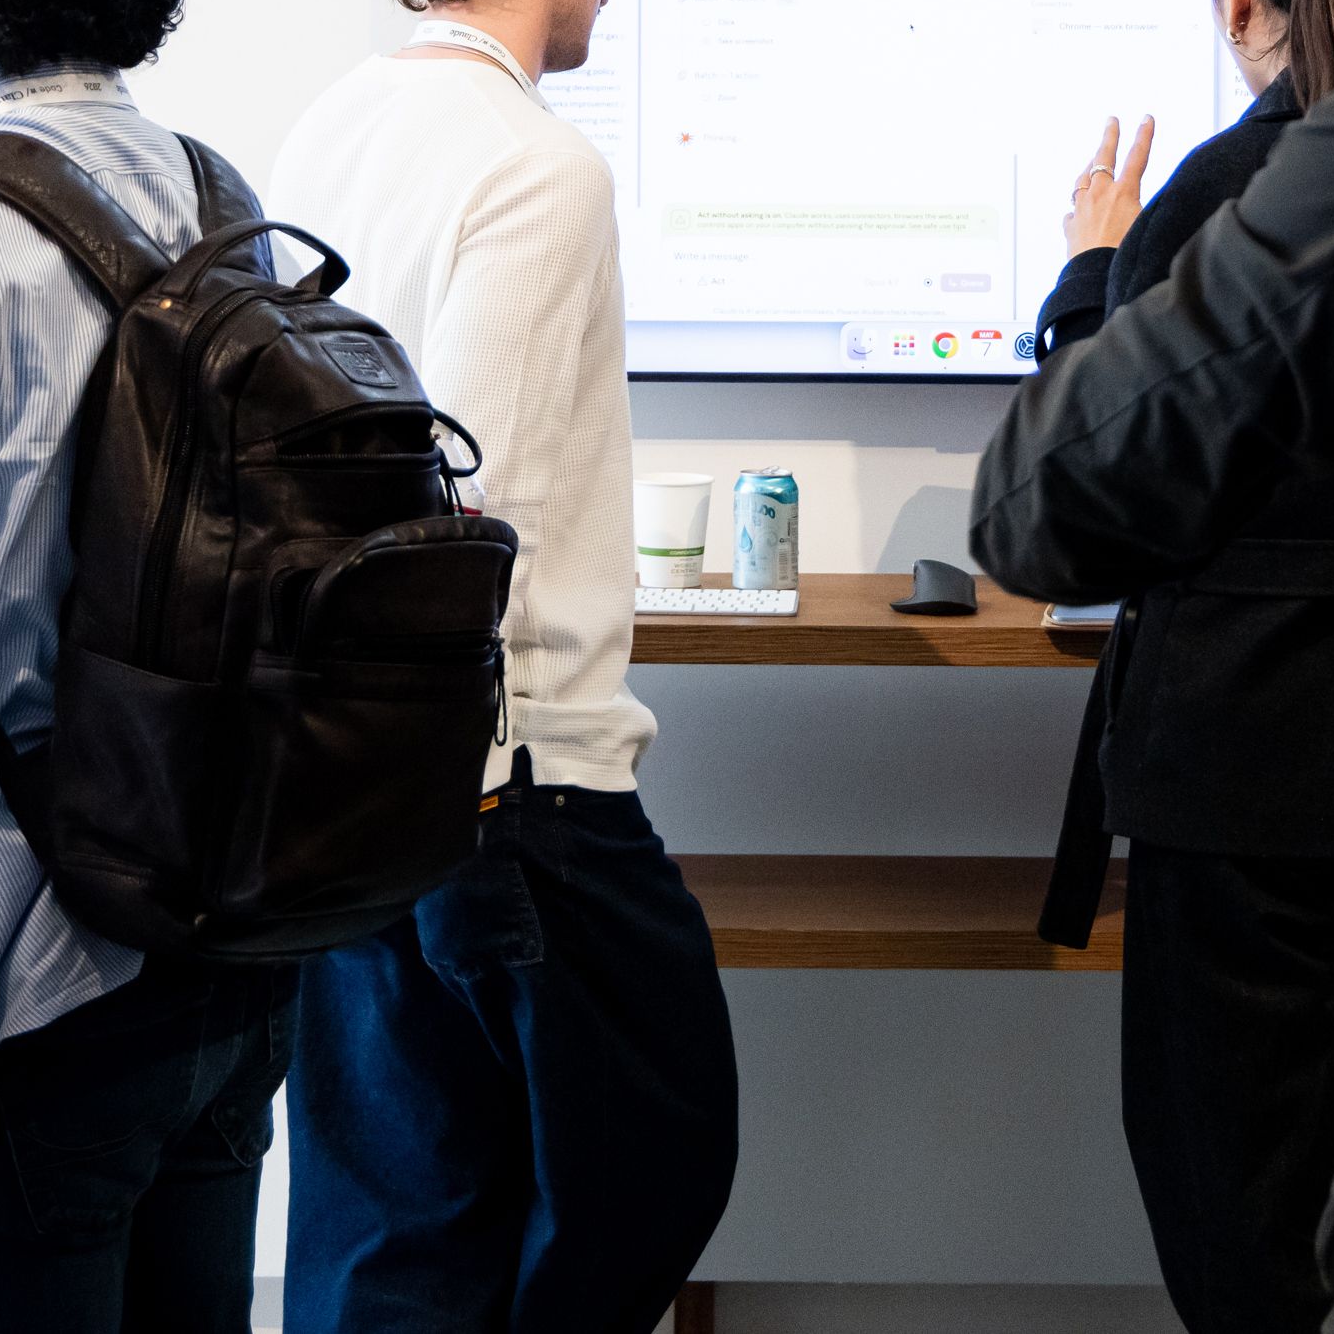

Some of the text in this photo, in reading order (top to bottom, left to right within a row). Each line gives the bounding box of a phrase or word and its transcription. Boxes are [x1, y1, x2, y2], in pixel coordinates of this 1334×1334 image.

[449, 29, 478, 42] Claude
[489, 44, 506, 58] Code
[27, 87, 37, 96] w/
[39, 84, 63, 93] Code
[84, 82, 102, 92] 2026
[740, 212, 764, 220] asking
[673, 252, 700, 260] Write
[981, 342, 992, 356] 7
